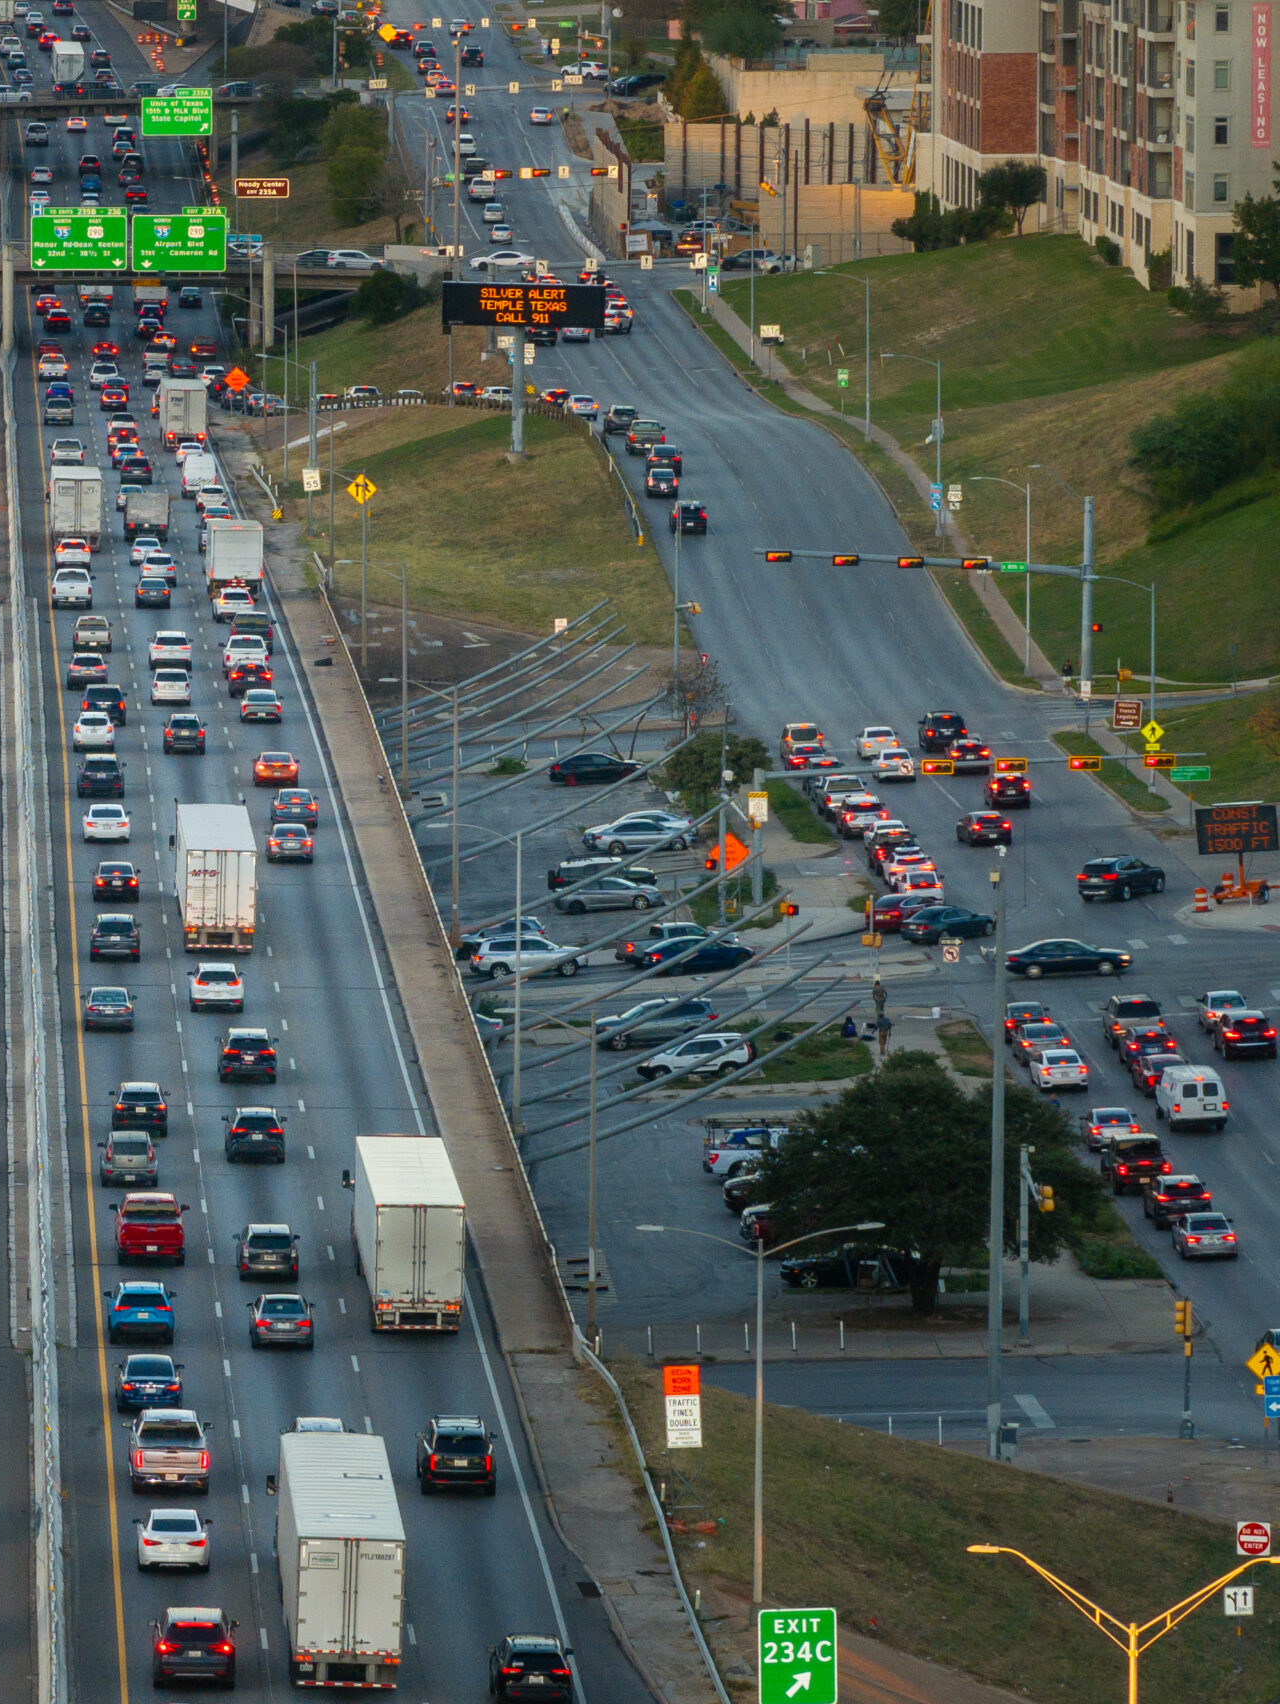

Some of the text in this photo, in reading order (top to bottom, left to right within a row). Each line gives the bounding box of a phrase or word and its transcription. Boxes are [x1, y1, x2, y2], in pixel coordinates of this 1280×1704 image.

[1255, 14, 1267, 48] NOW
[1257, 57, 1266, 139] LEASING
[174, 115, 202, 123] Capitol
[88, 227, 102, 236] 290
[189, 227, 203, 236] 290
[480, 288, 566, 299] SILVER ALERT
[480, 300, 567, 312] TEMPLE TEXAS
[496, 312, 549, 324] CALL 911
[306, 480, 318, 488] 55
[1212, 805, 1258, 820] CONST
[1205, 820, 1270, 836] TRAFFIC
[1207, 836, 1271, 852] 1500 FT
[668, 1398, 698, 1407] TRAFFIC
[673, 1408, 694, 1417] FINES
[669, 1419, 698, 1428] DOUBLE
[774, 1618, 821, 1634] EXIT
[763, 1640, 832, 1663] 234C
